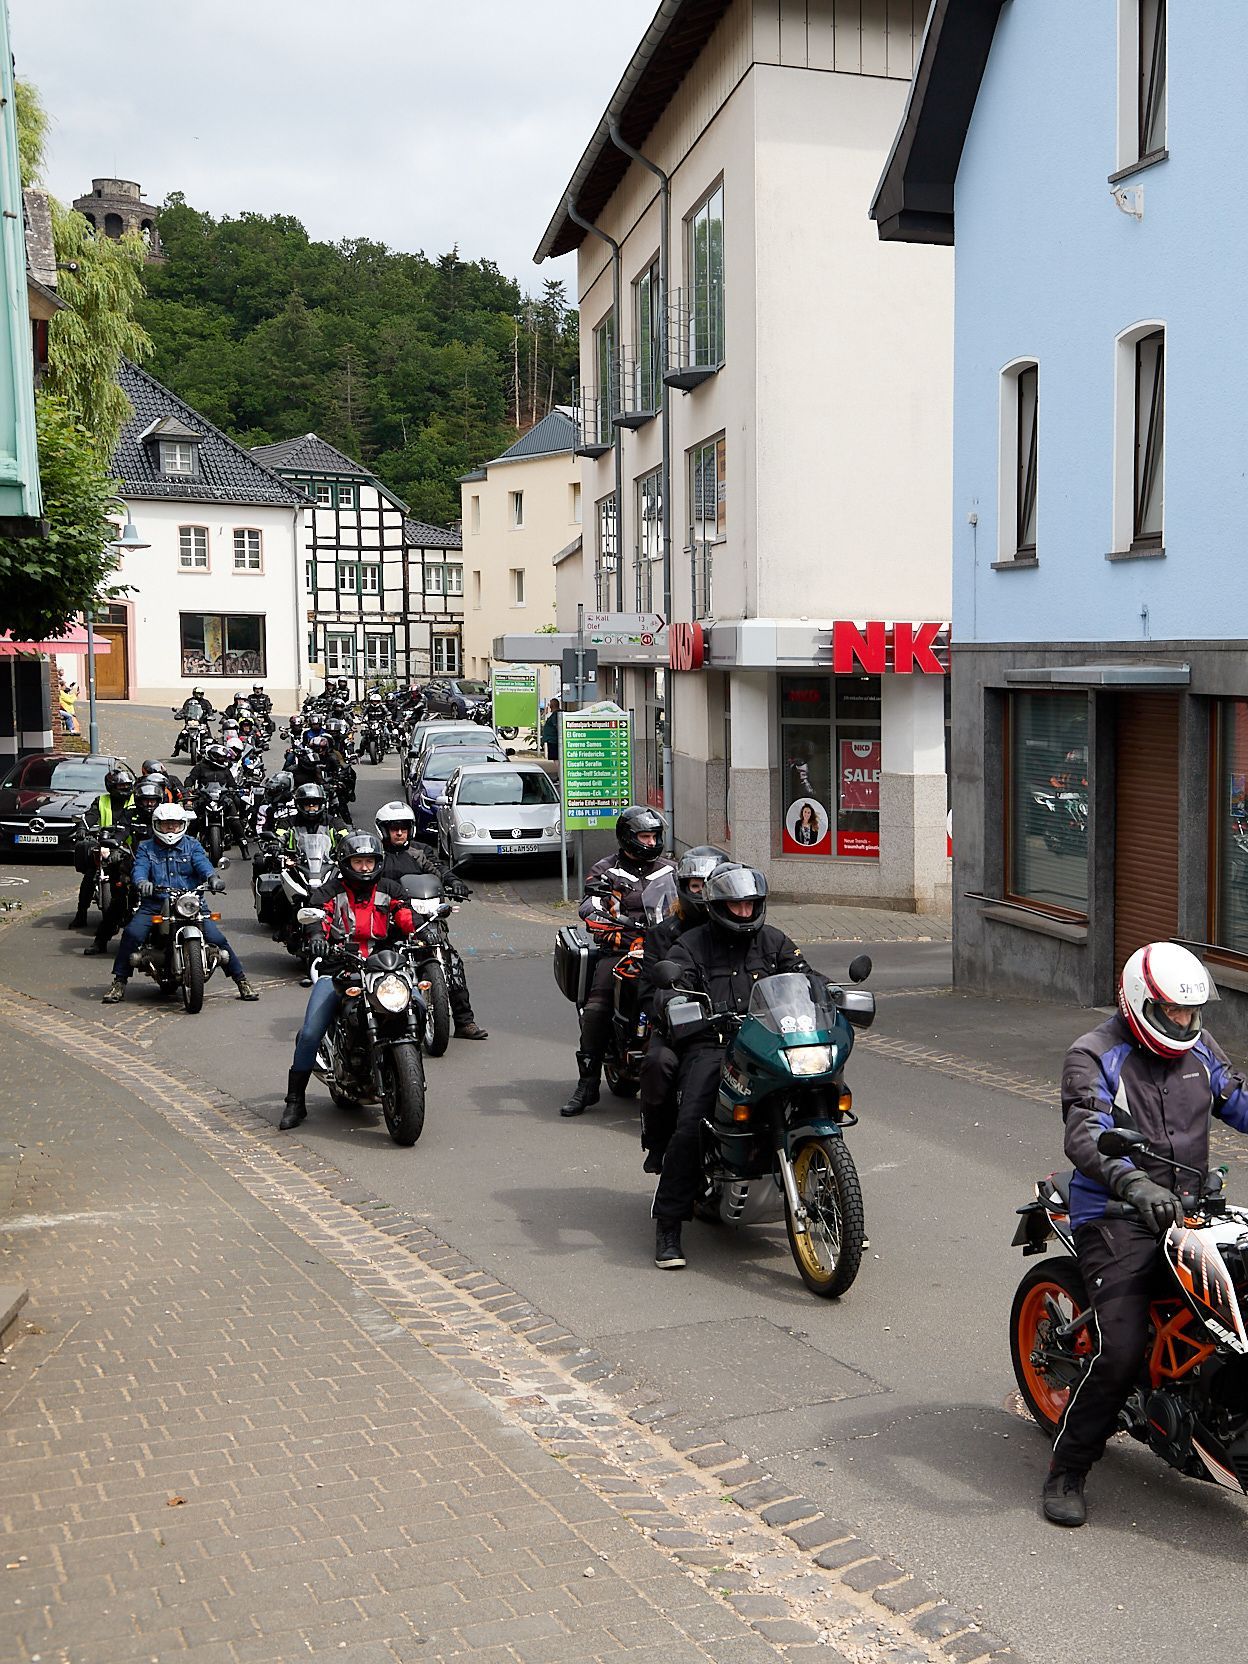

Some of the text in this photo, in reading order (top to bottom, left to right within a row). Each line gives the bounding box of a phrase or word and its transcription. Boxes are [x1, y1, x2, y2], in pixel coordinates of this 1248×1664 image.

[595, 614, 609, 622] Kall
[669, 621, 694, 671] NKD
[833, 620, 952, 674] NK
[853, 744, 871, 752] NKD
[843, 768, 880, 783] SALE
